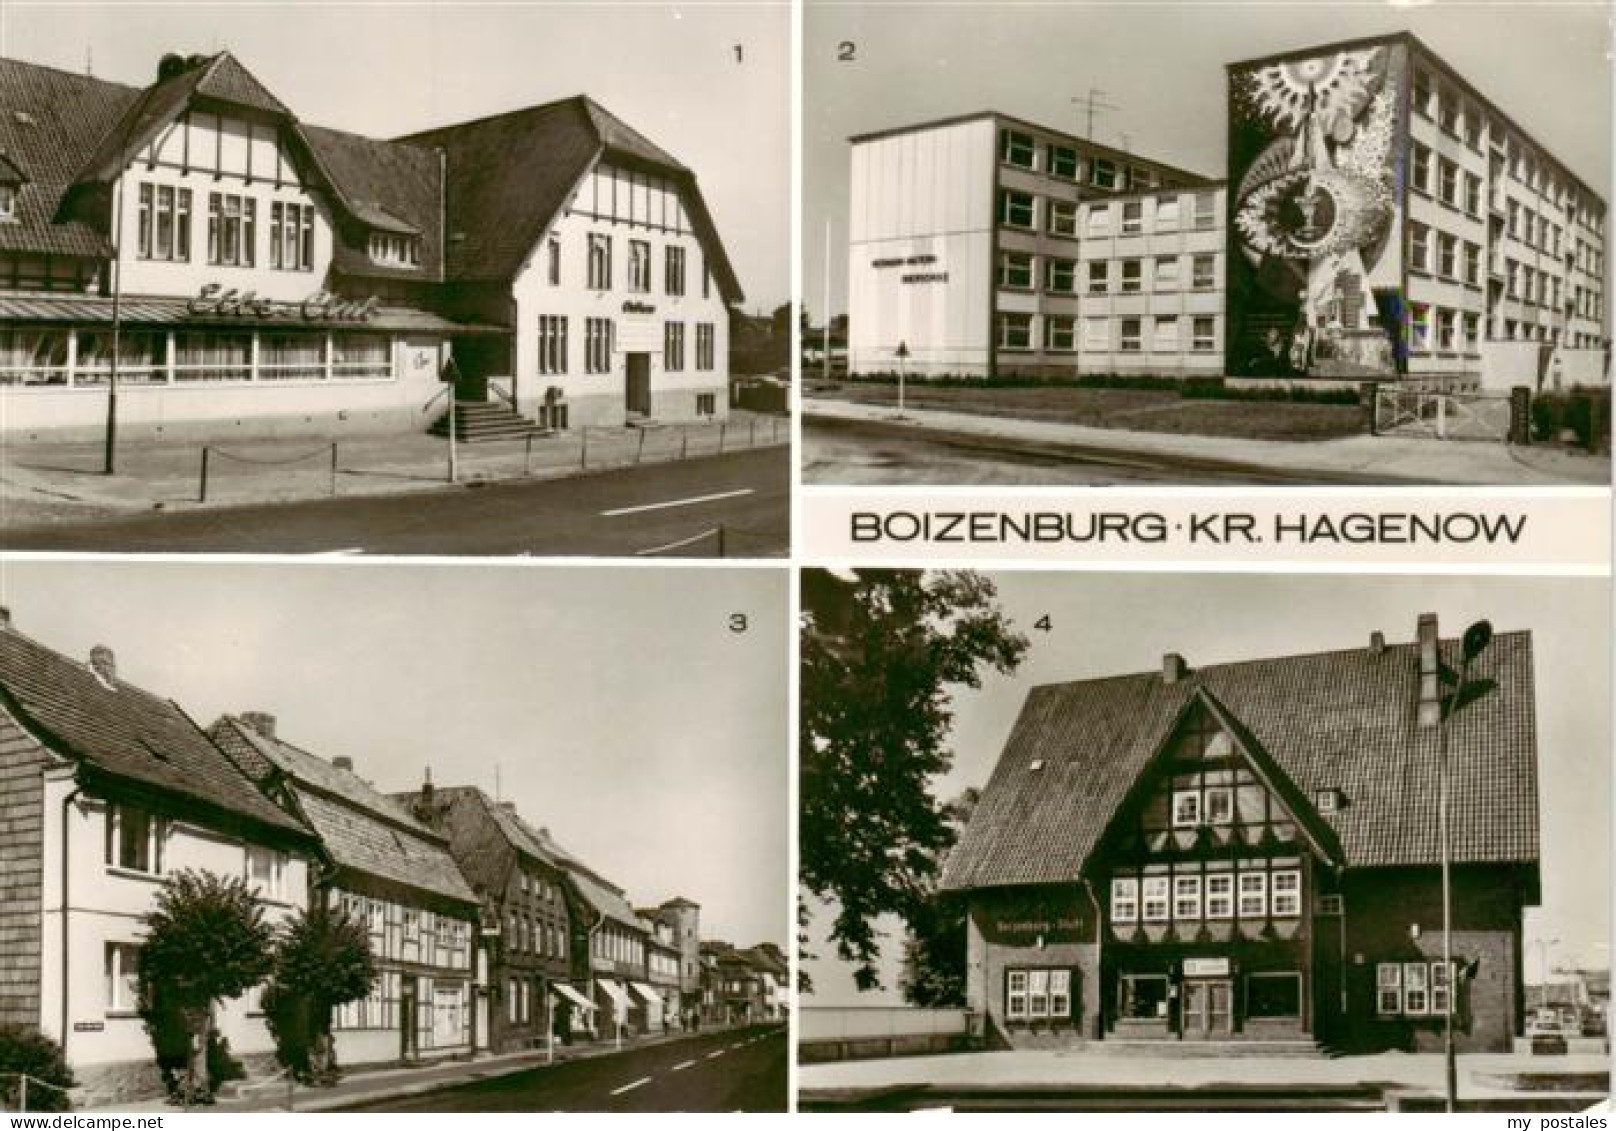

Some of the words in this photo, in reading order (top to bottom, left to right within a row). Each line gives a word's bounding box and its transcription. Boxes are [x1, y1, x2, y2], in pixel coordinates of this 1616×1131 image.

[734, 43, 743, 63] 1
[837, 41, 857, 60] 2
[851, 512, 1167, 543] BOIZENBURG
[1190, 513, 1262, 543] KR.
[1275, 512, 1527, 543] HAGENOW
[728, 613, 747, 633] 3
[1033, 613, 1054, 633] 4
